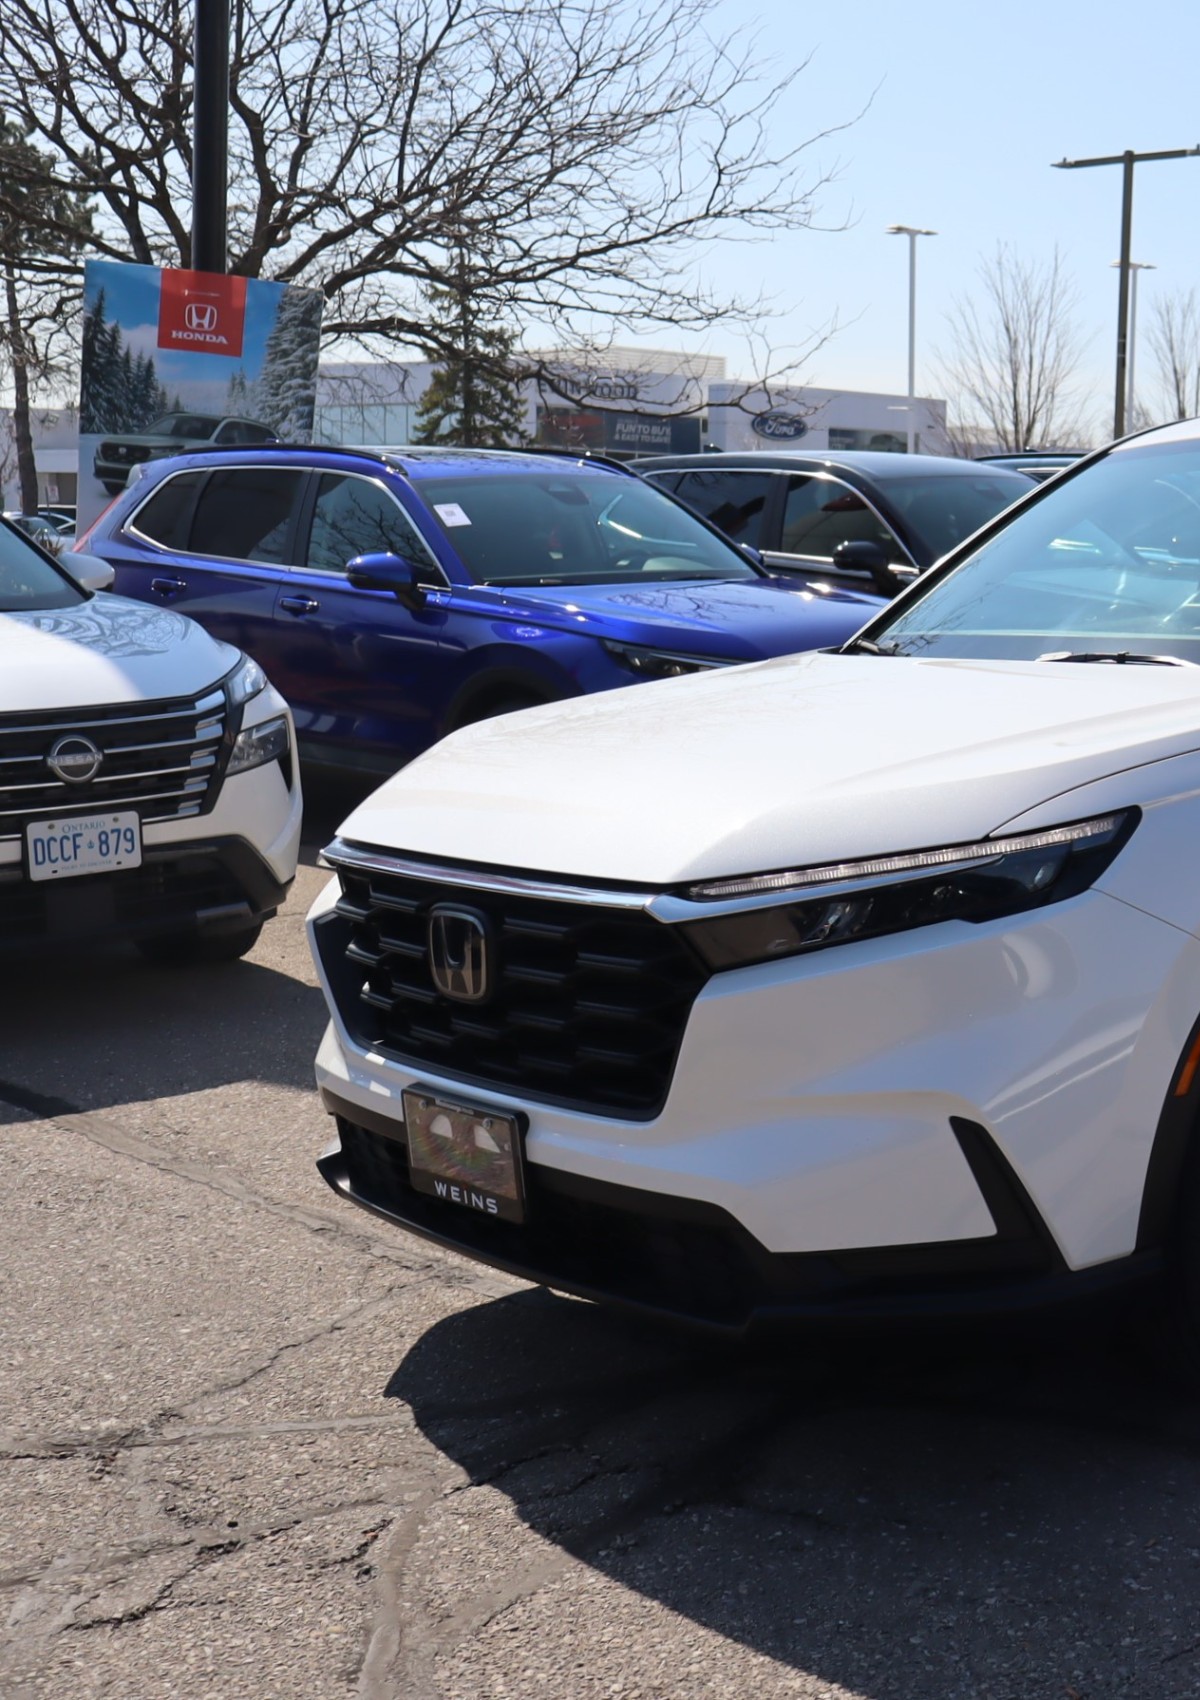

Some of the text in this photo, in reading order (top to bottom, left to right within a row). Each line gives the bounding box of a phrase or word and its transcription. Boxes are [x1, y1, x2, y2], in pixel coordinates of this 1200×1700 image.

[171, 330, 229, 345] HONDA
[616, 423, 671, 437] FUN TO BUY
[47, 752, 103, 766] NISSAN
[33, 828, 135, 866] DCCF 879
[434, 1180, 498, 1214] WEINS
